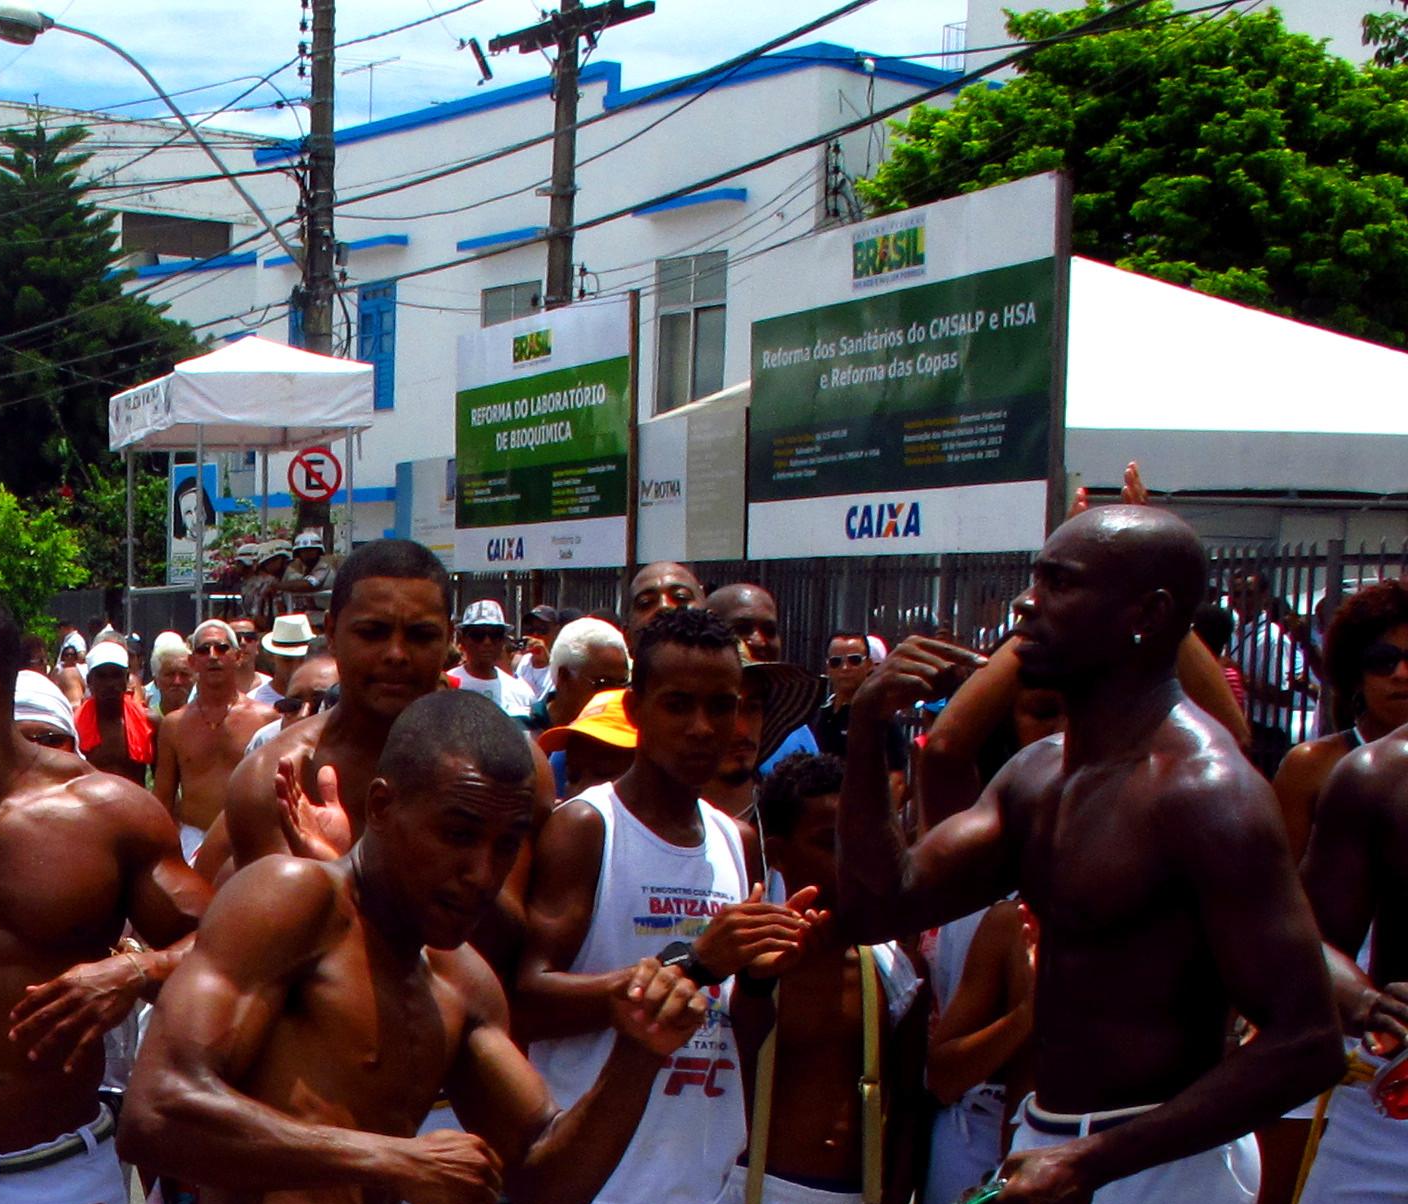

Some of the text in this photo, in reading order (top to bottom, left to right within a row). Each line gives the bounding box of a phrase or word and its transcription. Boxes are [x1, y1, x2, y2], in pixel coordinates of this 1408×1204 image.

[853, 226, 925, 279] BRASIL
[762, 302, 1036, 369] Reforma dos Sanitários do CMSALP e HSA
[820, 352, 958, 389] e Reforma das Copas
[471, 381, 606, 427] REFORMA DO LABORATÓRIO
[496, 420, 573, 451] DE BIOQUÍMICA
[845, 502, 920, 540] CAIXA
[487, 536, 524, 562] CAIXA
[649, 896, 723, 917] BATIZAD
[662, 1056, 735, 1098] FC
